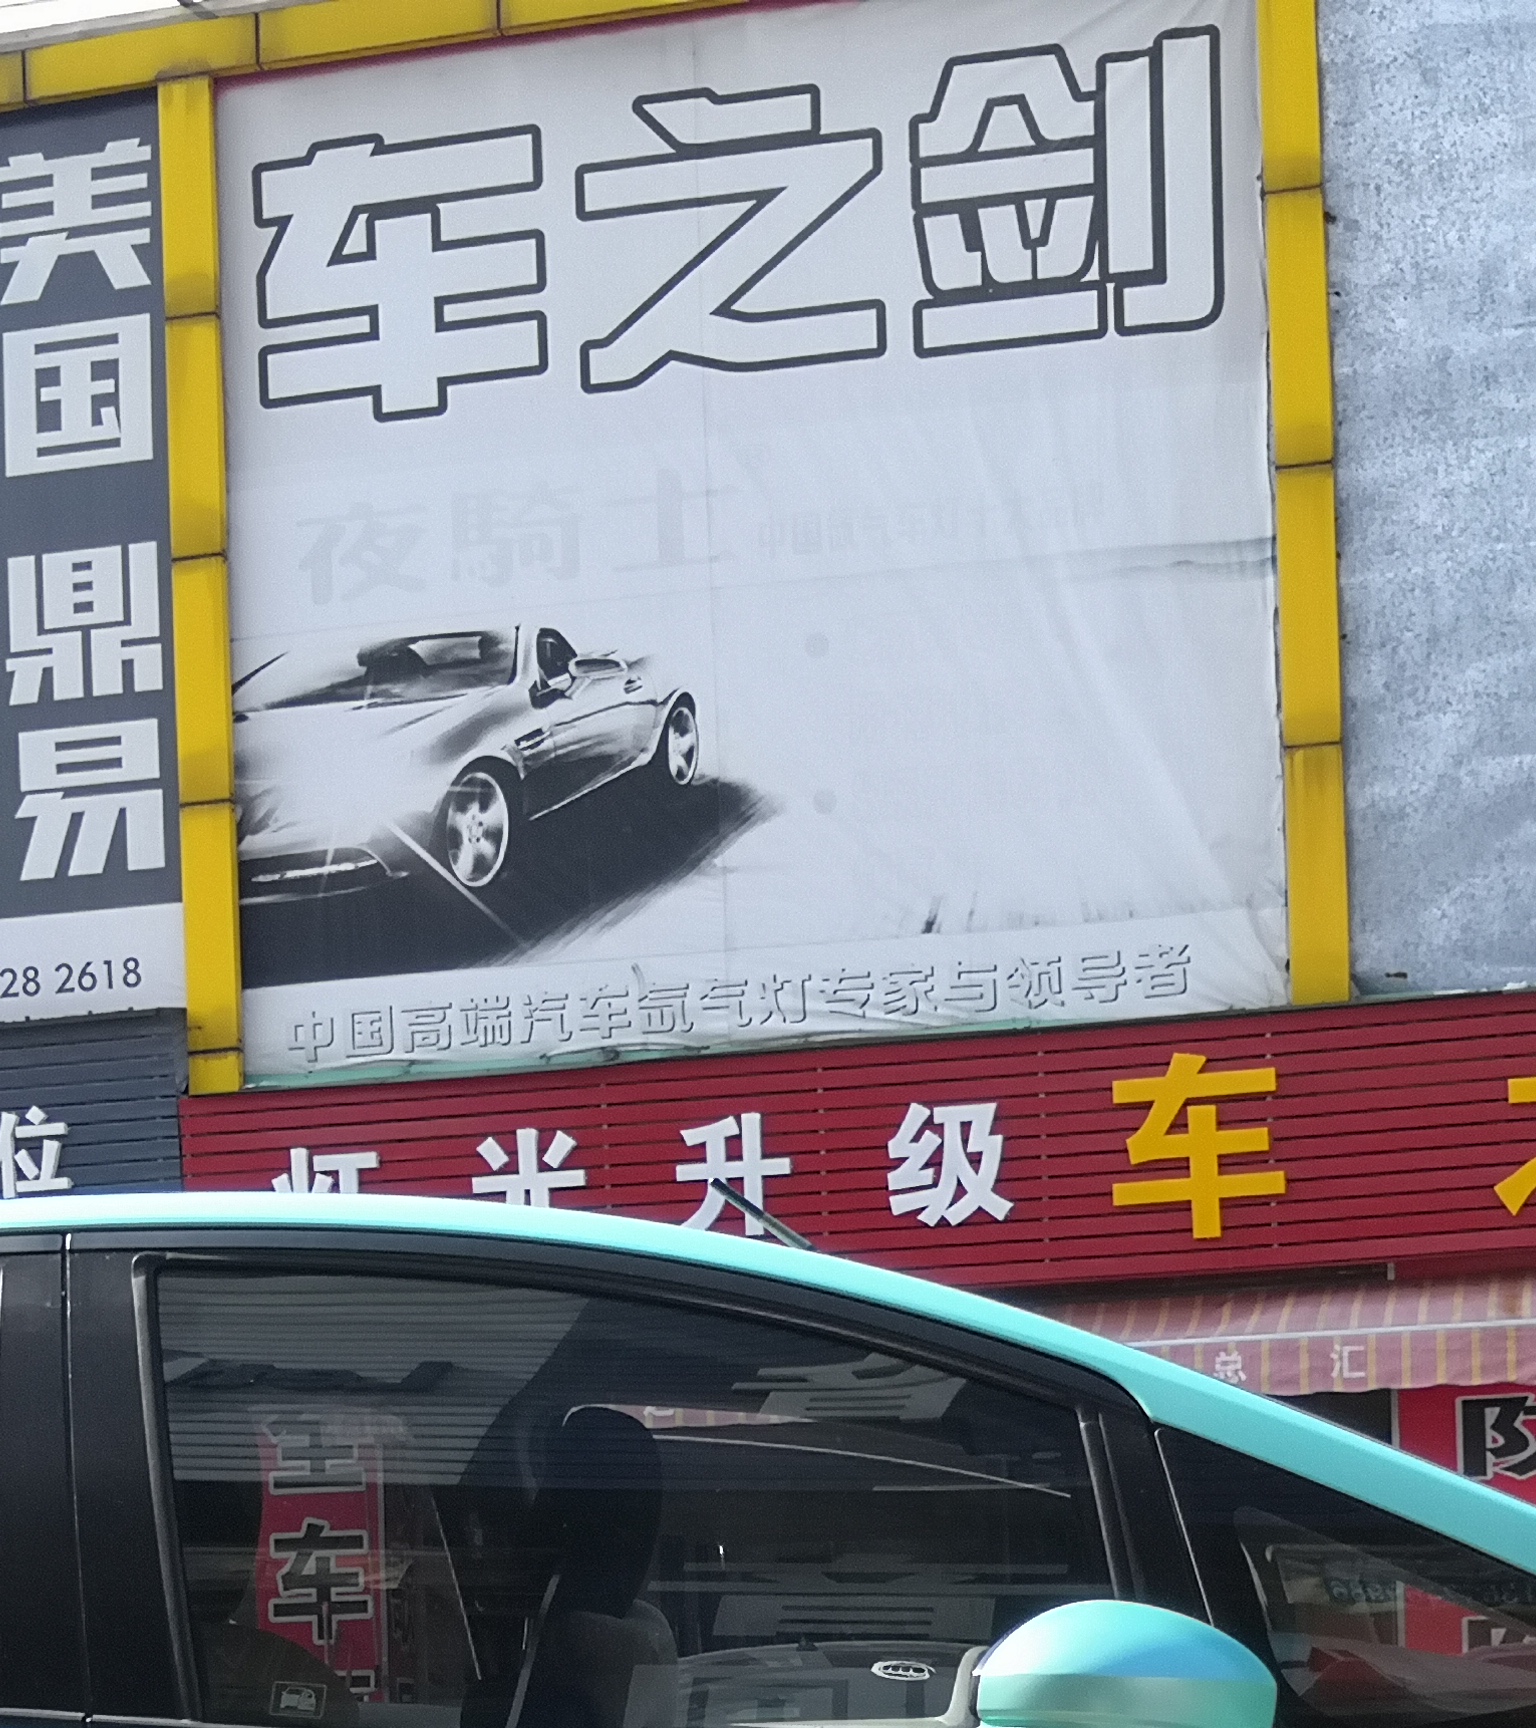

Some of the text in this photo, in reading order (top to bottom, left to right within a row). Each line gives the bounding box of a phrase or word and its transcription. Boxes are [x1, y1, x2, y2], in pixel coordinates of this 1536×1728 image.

[252, 25, 1226, 423] 车之剑
[5, 540, 166, 882] 鼎易
[54, 956, 142, 994] 2618
[288, 943, 1192, 1064] 中国高端汽车氙气灯专家与领导者
